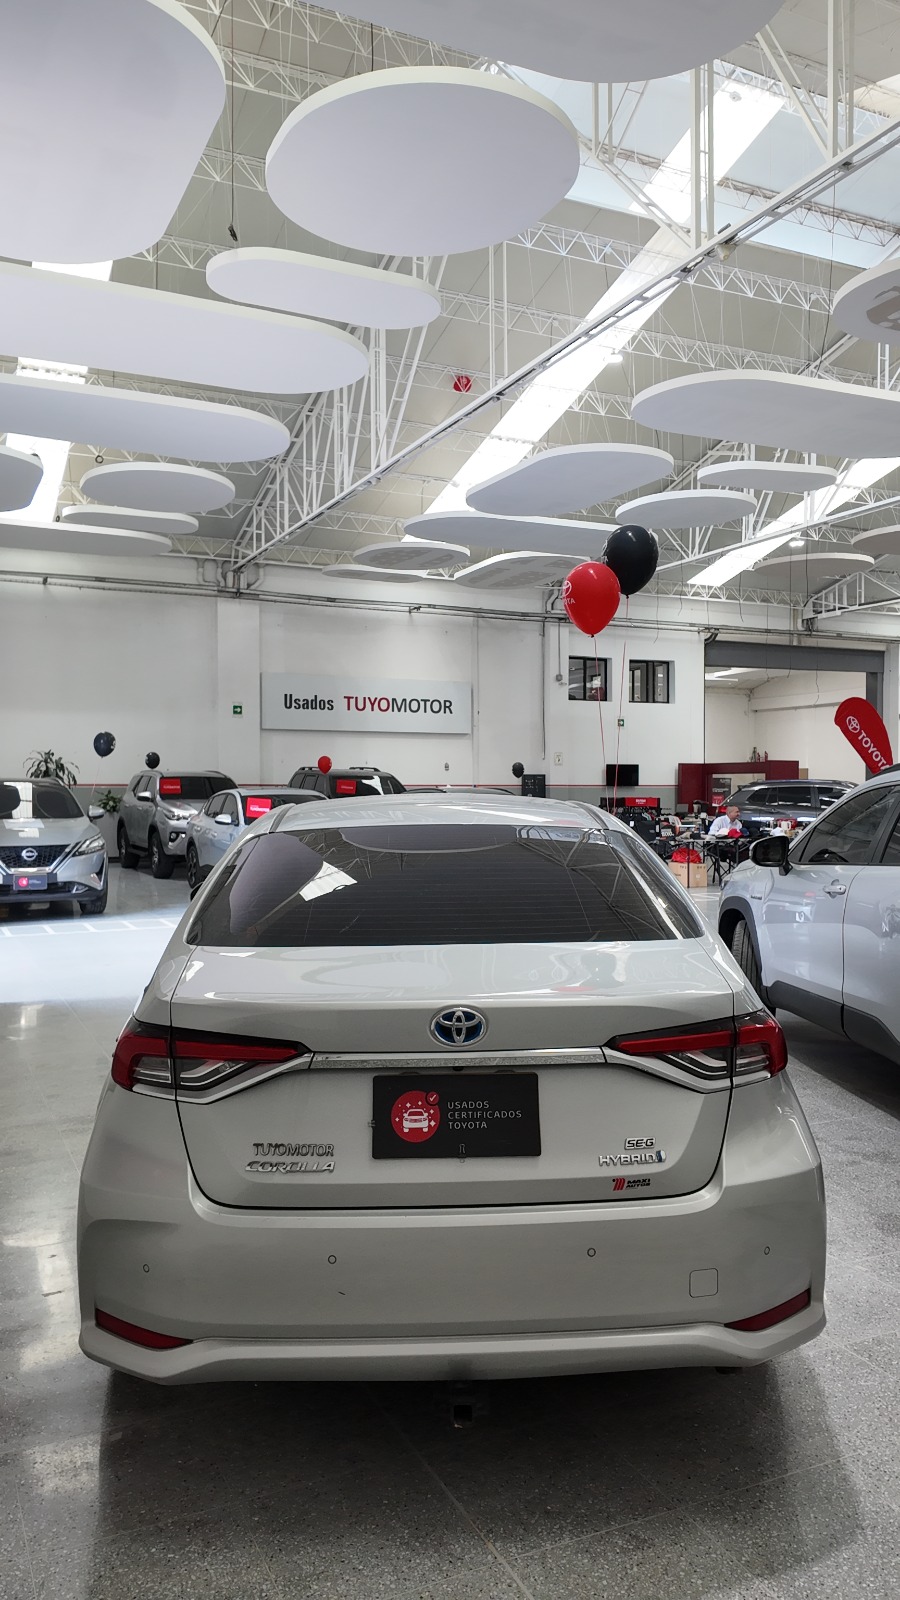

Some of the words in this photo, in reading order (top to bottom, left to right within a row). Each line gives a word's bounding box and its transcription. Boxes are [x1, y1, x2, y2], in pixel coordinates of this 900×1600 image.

[284, 693, 334, 711] Usados
[343, 696, 453, 714] TUYOMOTOR
[447, 1101, 490, 1109] USADOS
[447, 1110, 522, 1119] CERTIFICADOS
[447, 1121, 488, 1129] TOYOTA
[252, 1142, 335, 1157] TUYOMOTOR
[599, 1154, 656, 1166] HYBRID
[245, 1160, 336, 1174] COROLLA
